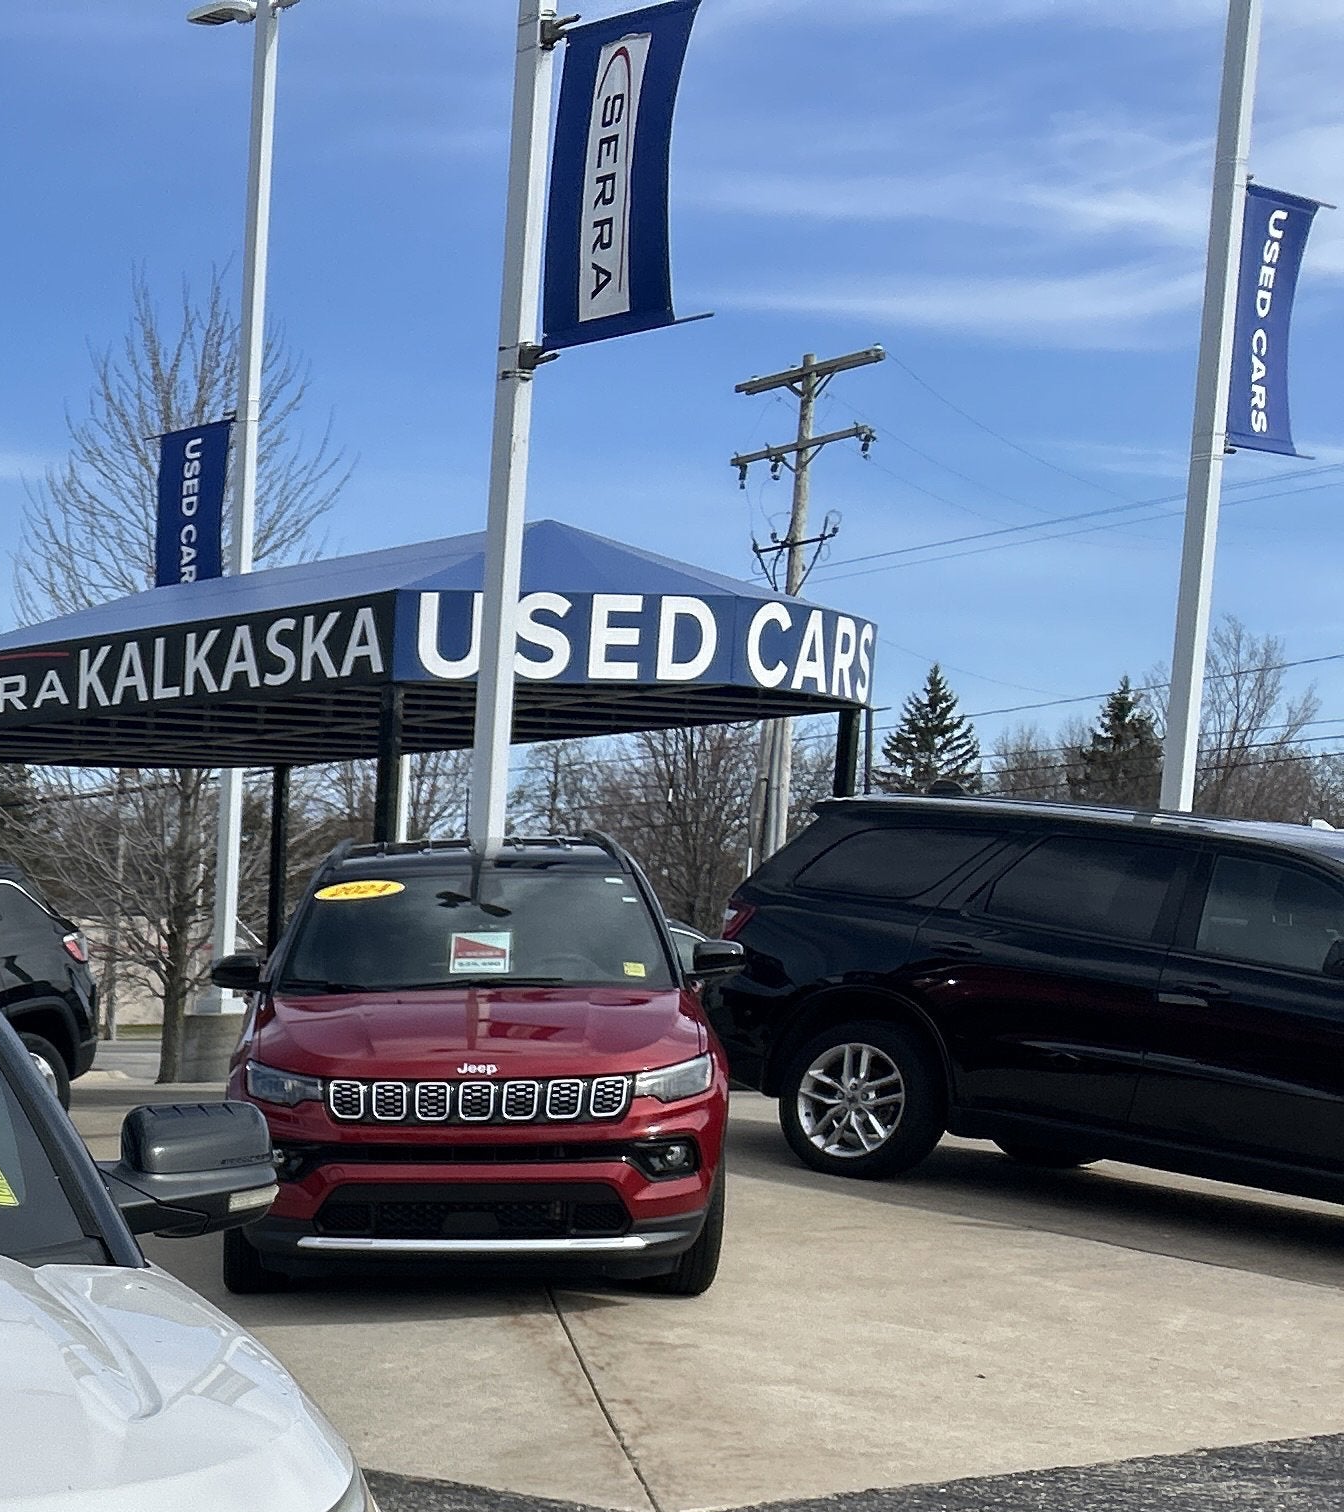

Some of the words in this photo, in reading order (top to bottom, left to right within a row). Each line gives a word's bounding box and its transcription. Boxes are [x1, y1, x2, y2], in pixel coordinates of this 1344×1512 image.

[591, 93, 624, 300] SERRA
[1255, 209, 1288, 318] USED
[1250, 328, 1268, 433] CARS
[181, 437, 203, 517] USED
[180, 524, 198, 584] CAR
[77, 606, 385, 710] KALKASKA
[418, 592, 717, 681] USED
[747, 602, 873, 703] CARS
[457, 1062, 498, 1075] Jeep
